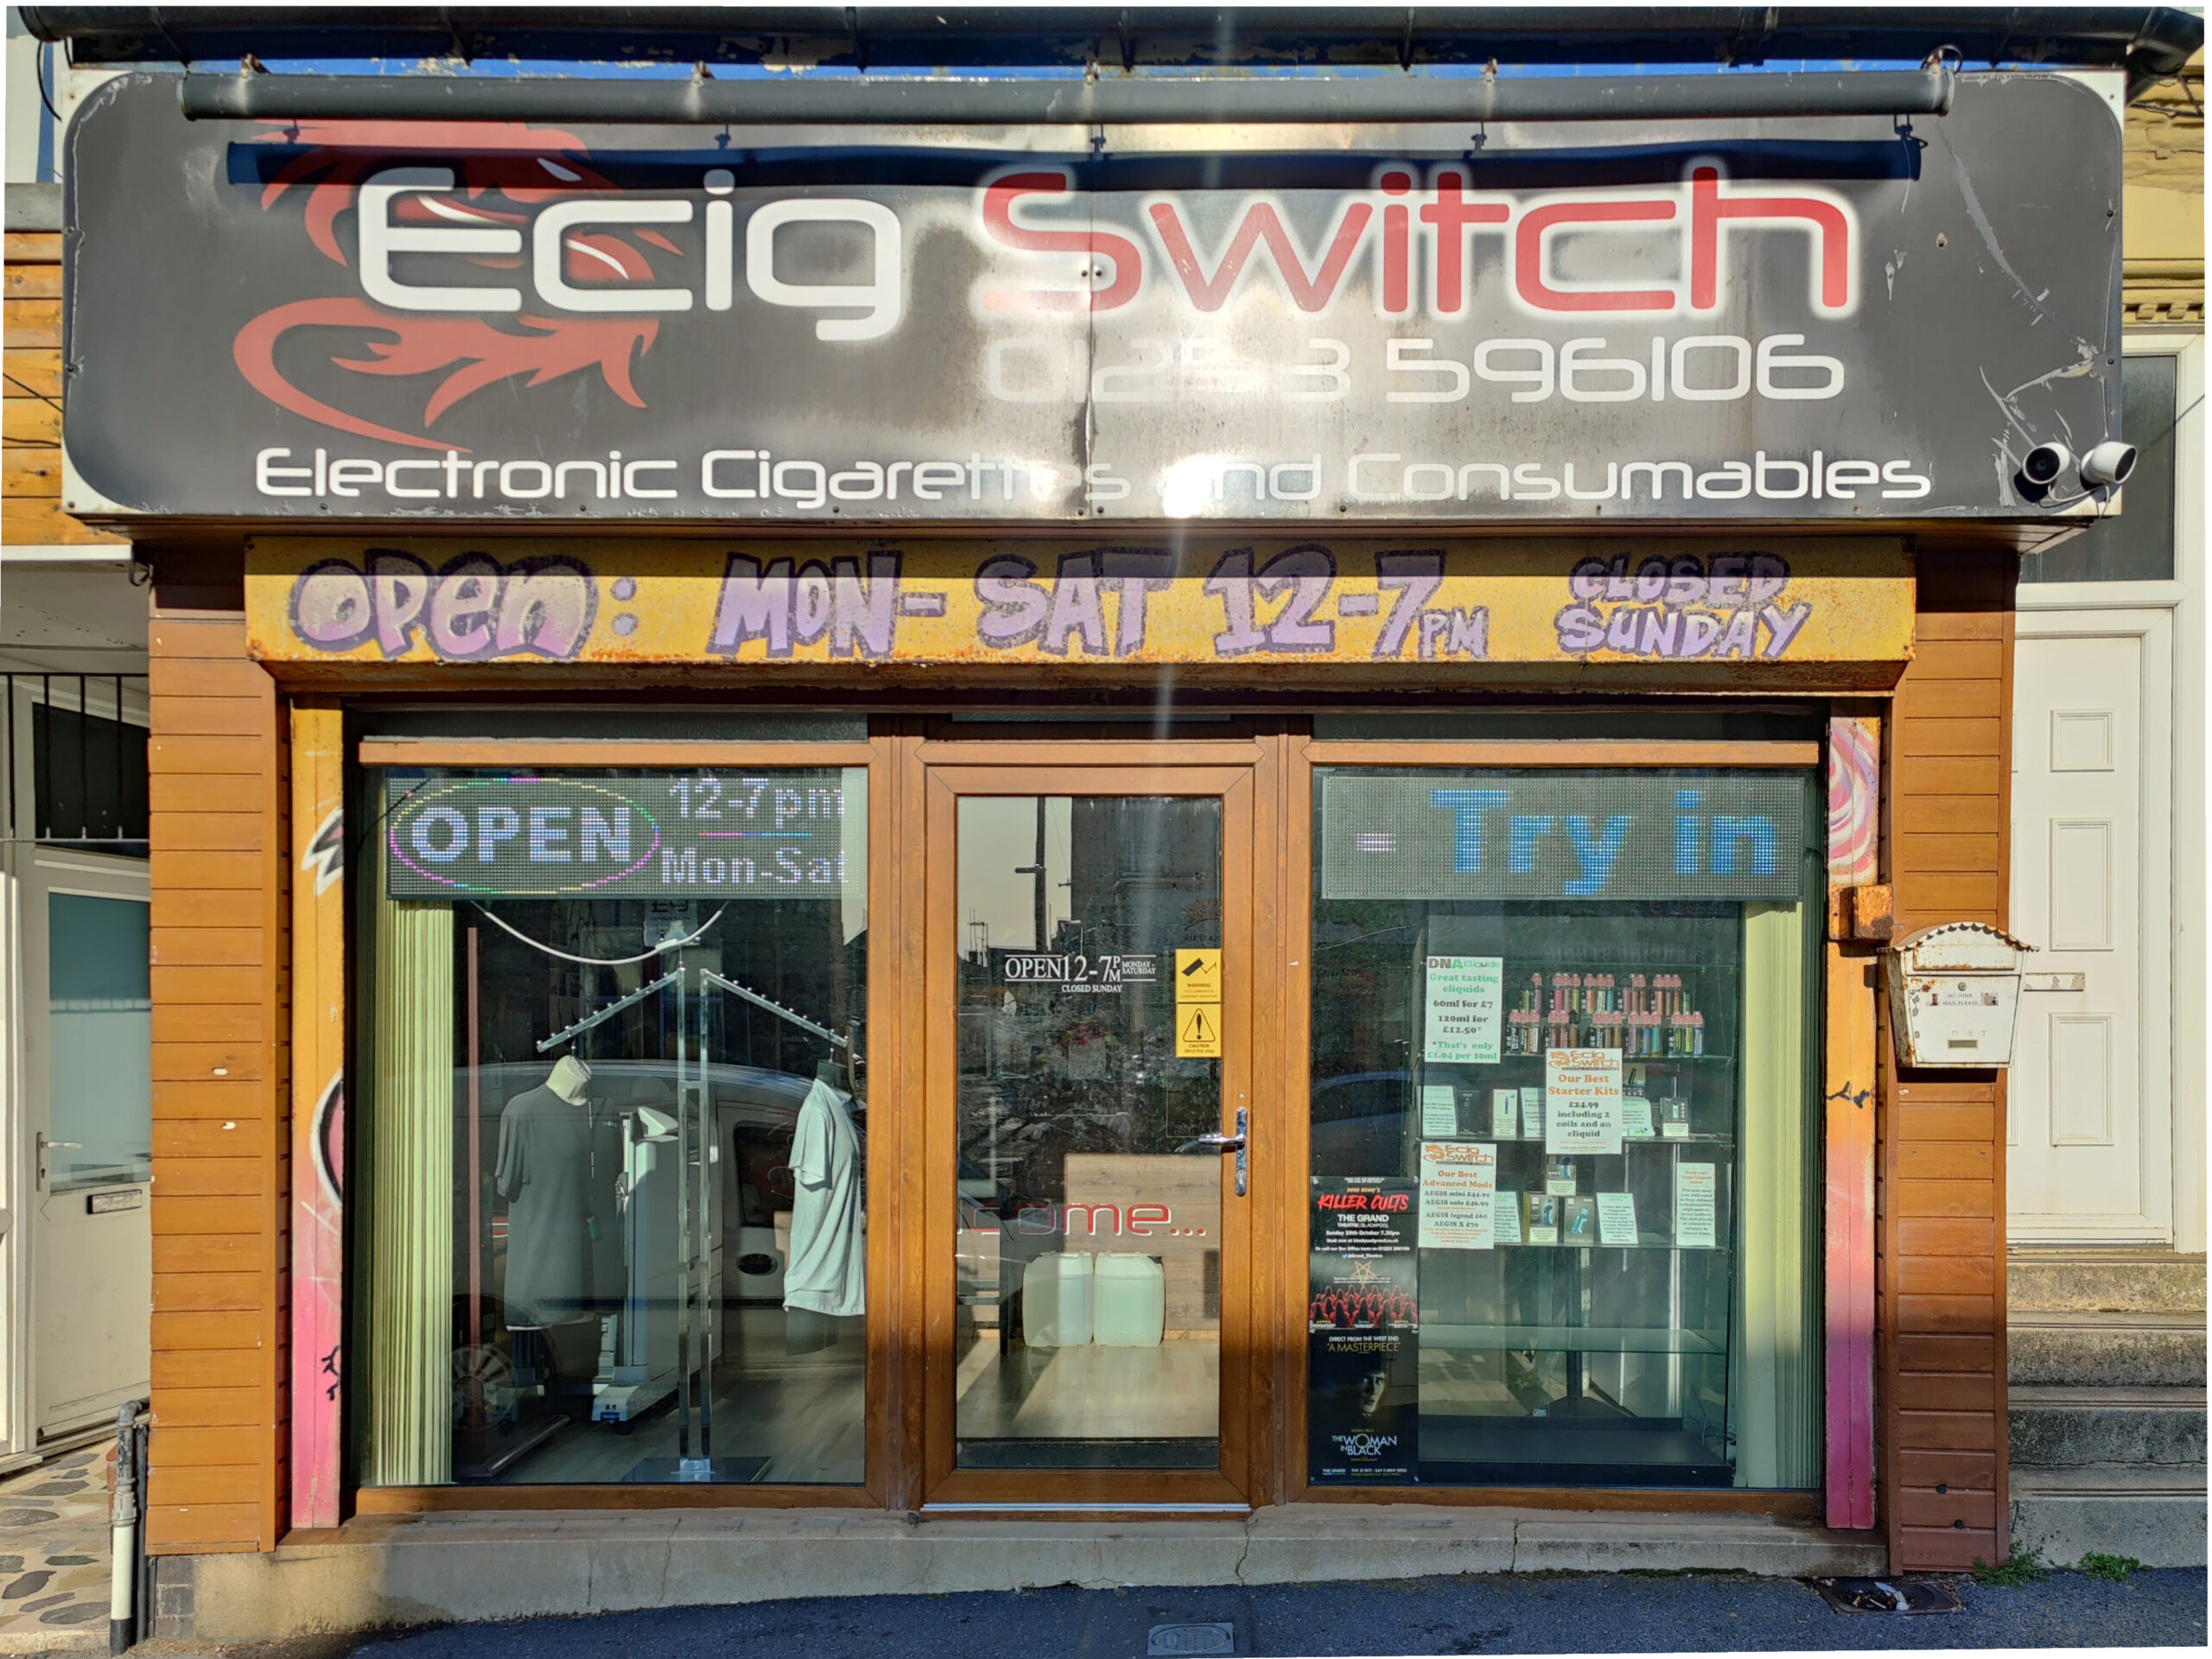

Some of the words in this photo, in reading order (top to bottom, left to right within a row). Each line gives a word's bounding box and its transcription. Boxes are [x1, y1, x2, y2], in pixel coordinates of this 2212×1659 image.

[359, 166, 901, 341] Ecig
[981, 167, 1849, 313] Switch
[1387, 334, 1845, 402] 596106
[256, 448, 677, 499] Electronic
[702, 449, 1132, 509] Cigarettes
[1158, 453, 1322, 501] nd
[1347, 450, 1932, 500] Consumables
[1567, 551, 1791, 608] CLOSED
[972, 545, 1178, 659] SAT
[1555, 601, 1812, 662] SUNDAY
[411, 807, 630, 863] OPEN
[1429, 789, 1634, 895] Try
[1675, 789, 1778, 875] in
[661, 847, 849, 884] Mon-Sat
[1005, 957, 1062, 979] OPEN
[1428, 958, 1463, 969] DNA
[1429, 973, 1459, 982] Great
[1461, 974, 1499, 983] tasting
[1061, 984, 1091, 993] CLOSED
[1092, 984, 1122, 993] SUNDAY
[1442, 985, 1484, 994] eliquids
[1433, 999, 1459, 1007] 60ml
[1471, 1042, 1493, 1051] only
[1570, 1050, 1605, 1059] Ecig
[1572, 1058, 1620, 1067] Switch
[1558, 1074, 1581, 1083] Our
[1584, 1074, 1609, 1083] Best
[1548, 1086, 1592, 1096] Starter
[1594, 1086, 1619, 1096] Kits
[1557, 1110, 1603, 1119] including
[1567, 1130, 1600, 1139] eliquid
[1445, 1144, 1480, 1154] Ecig
[1469, 1180, 1493, 1189] Mods
[1318, 1194, 1367, 1212] KILLER
[1370, 1194, 1409, 1213] CULTS
[1343, 1433, 1397, 1448] WOMAN
[1347, 1446, 1382, 1455] BLACK
